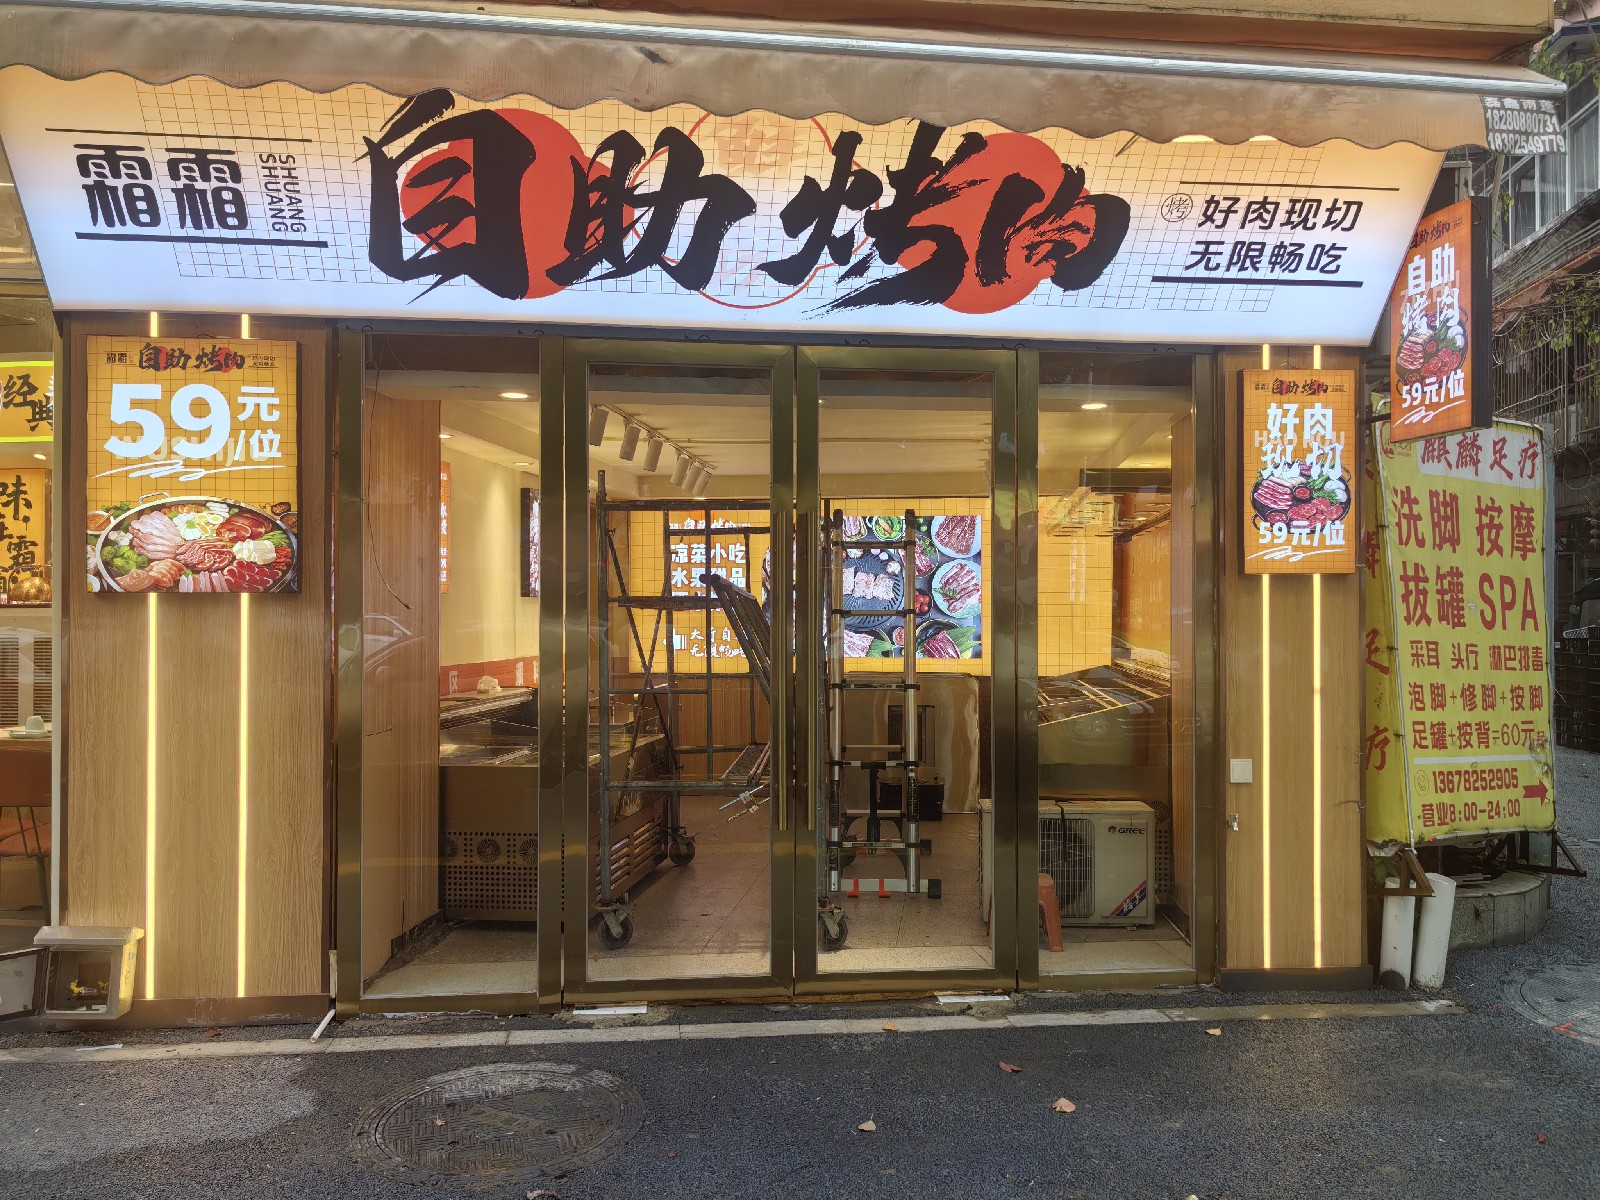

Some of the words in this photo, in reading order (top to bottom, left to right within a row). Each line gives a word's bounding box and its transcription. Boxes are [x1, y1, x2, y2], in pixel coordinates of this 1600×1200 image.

[1486, 109, 1560, 133] 18280880731
[259, 153, 288, 232] SHUANG
[279, 154, 306, 233] SHUANG
[354, 88, 1131, 316] 自助烤肉
[1198, 195, 1364, 231] 好肉现切
[1185, 241, 1348, 274] 无限畅吃
[1408, 243, 1455, 296] 自助
[1402, 285, 1460, 338] 烤肉
[139, 342, 245, 373] 自助烤肉
[1271, 377, 1328, 396] 自助烤肉
[1402, 369, 1465, 408] 59元/位
[1267, 403, 1333, 440] 好肉
[1260, 442, 1344, 480] 现切
[1258, 521, 1345, 546] 59元/位
[1392, 486, 1461, 553] 洗脚
[1475, 496, 1536, 561] 按摩
[1400, 561, 1467, 629] 拔罐
[1479, 573, 1539, 632] SPA
[1432, 768, 1519, 794] 13678252905
[1117, 827, 1145, 836] GREE
